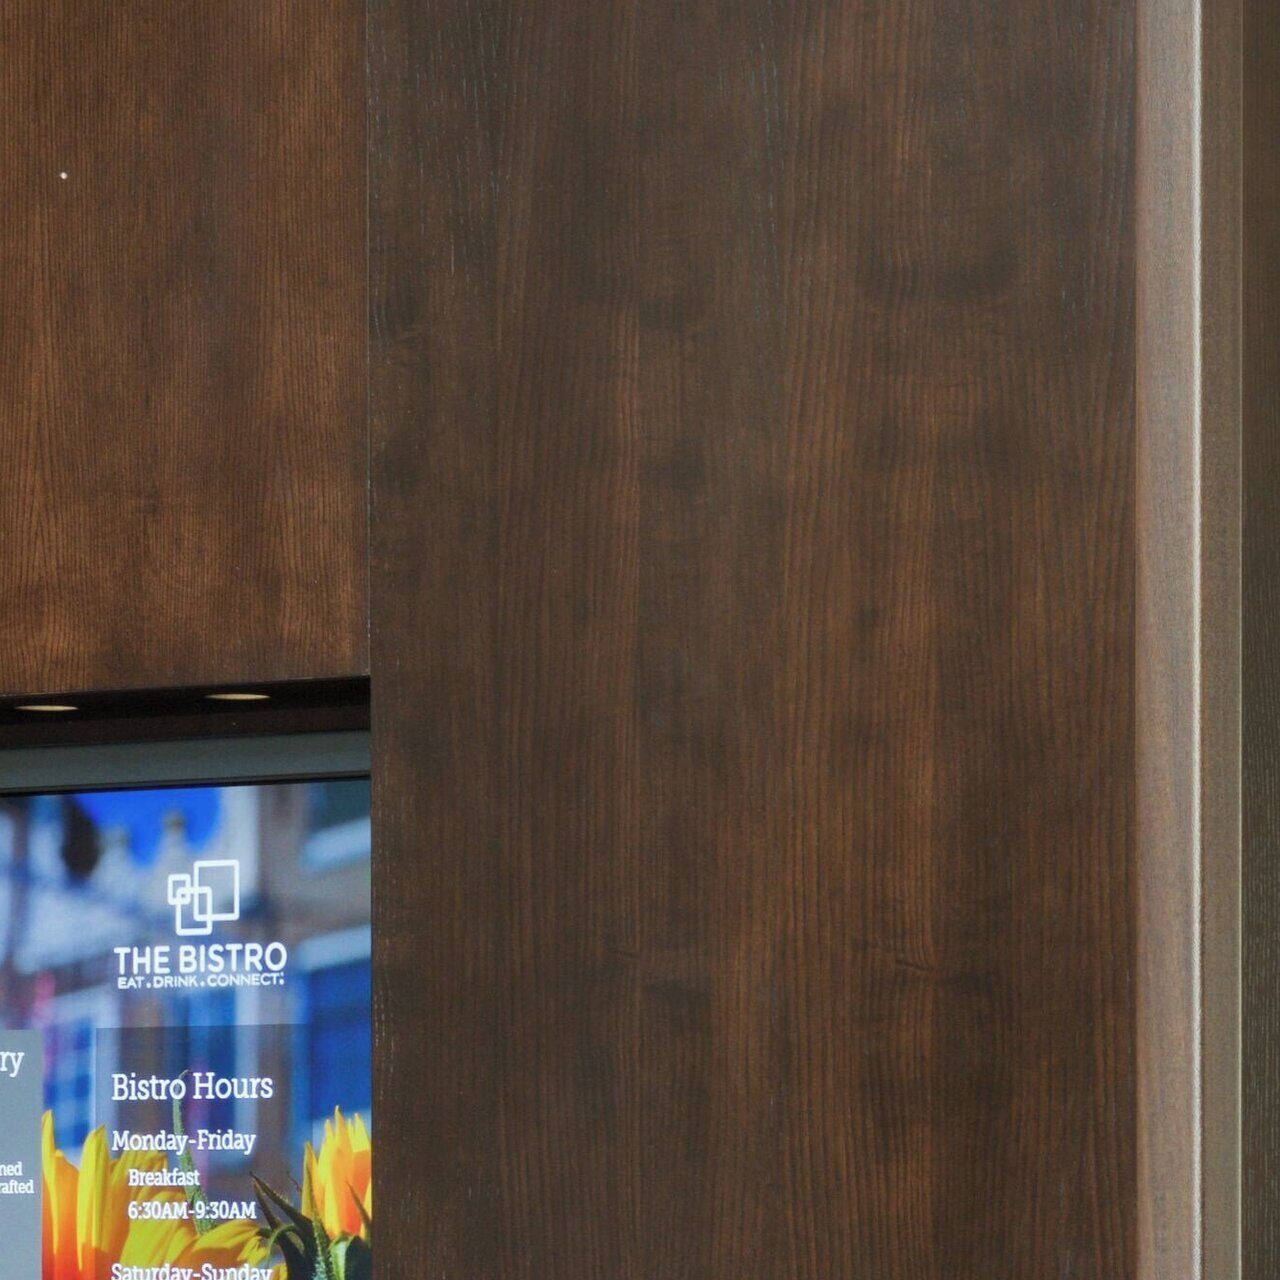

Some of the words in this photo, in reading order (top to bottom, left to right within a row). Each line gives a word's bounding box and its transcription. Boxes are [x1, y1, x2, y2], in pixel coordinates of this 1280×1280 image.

[114, 945, 170, 975] THE
[179, 942, 287, 973] BISTRO
[112, 1072, 186, 1100] Bistro
[193, 1072, 273, 1099] Hours
[112, 1129, 256, 1155] Monday-Friday
[128, 1168, 200, 1186] Breakfast
[128, 1200, 256, 1219] 6:30AM-9:30AM
